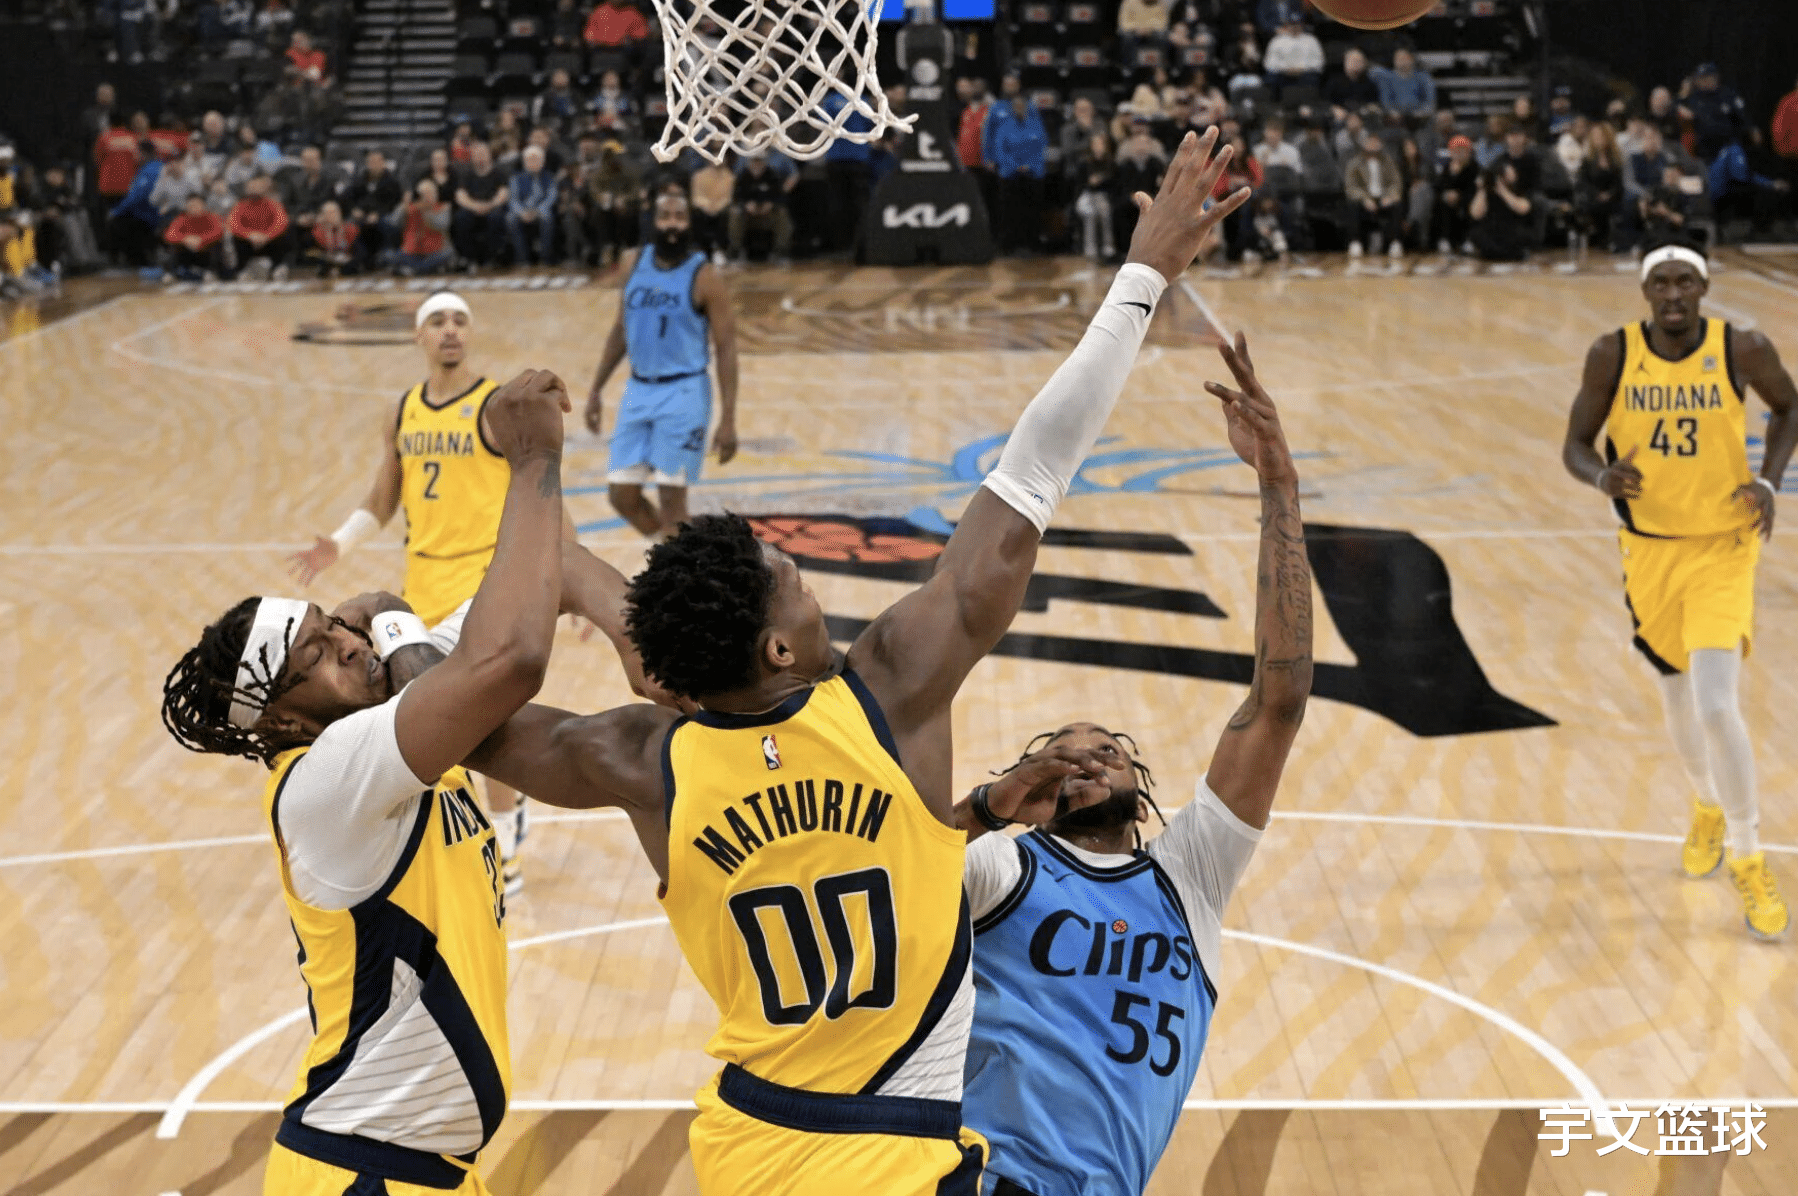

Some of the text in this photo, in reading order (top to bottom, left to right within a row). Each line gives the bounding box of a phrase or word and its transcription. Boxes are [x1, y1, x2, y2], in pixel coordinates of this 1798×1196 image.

[659, 315, 668, 338] 1
[1624, 383, 1722, 412] INDIANA
[1650, 418, 1698, 457] 43
[424, 461, 439, 499] 2
[692, 778, 893, 876] MATHURIN
[728, 866, 899, 1027] 00
[1028, 908, 1193, 984] Clips
[1105, 989, 1186, 1078] 55
